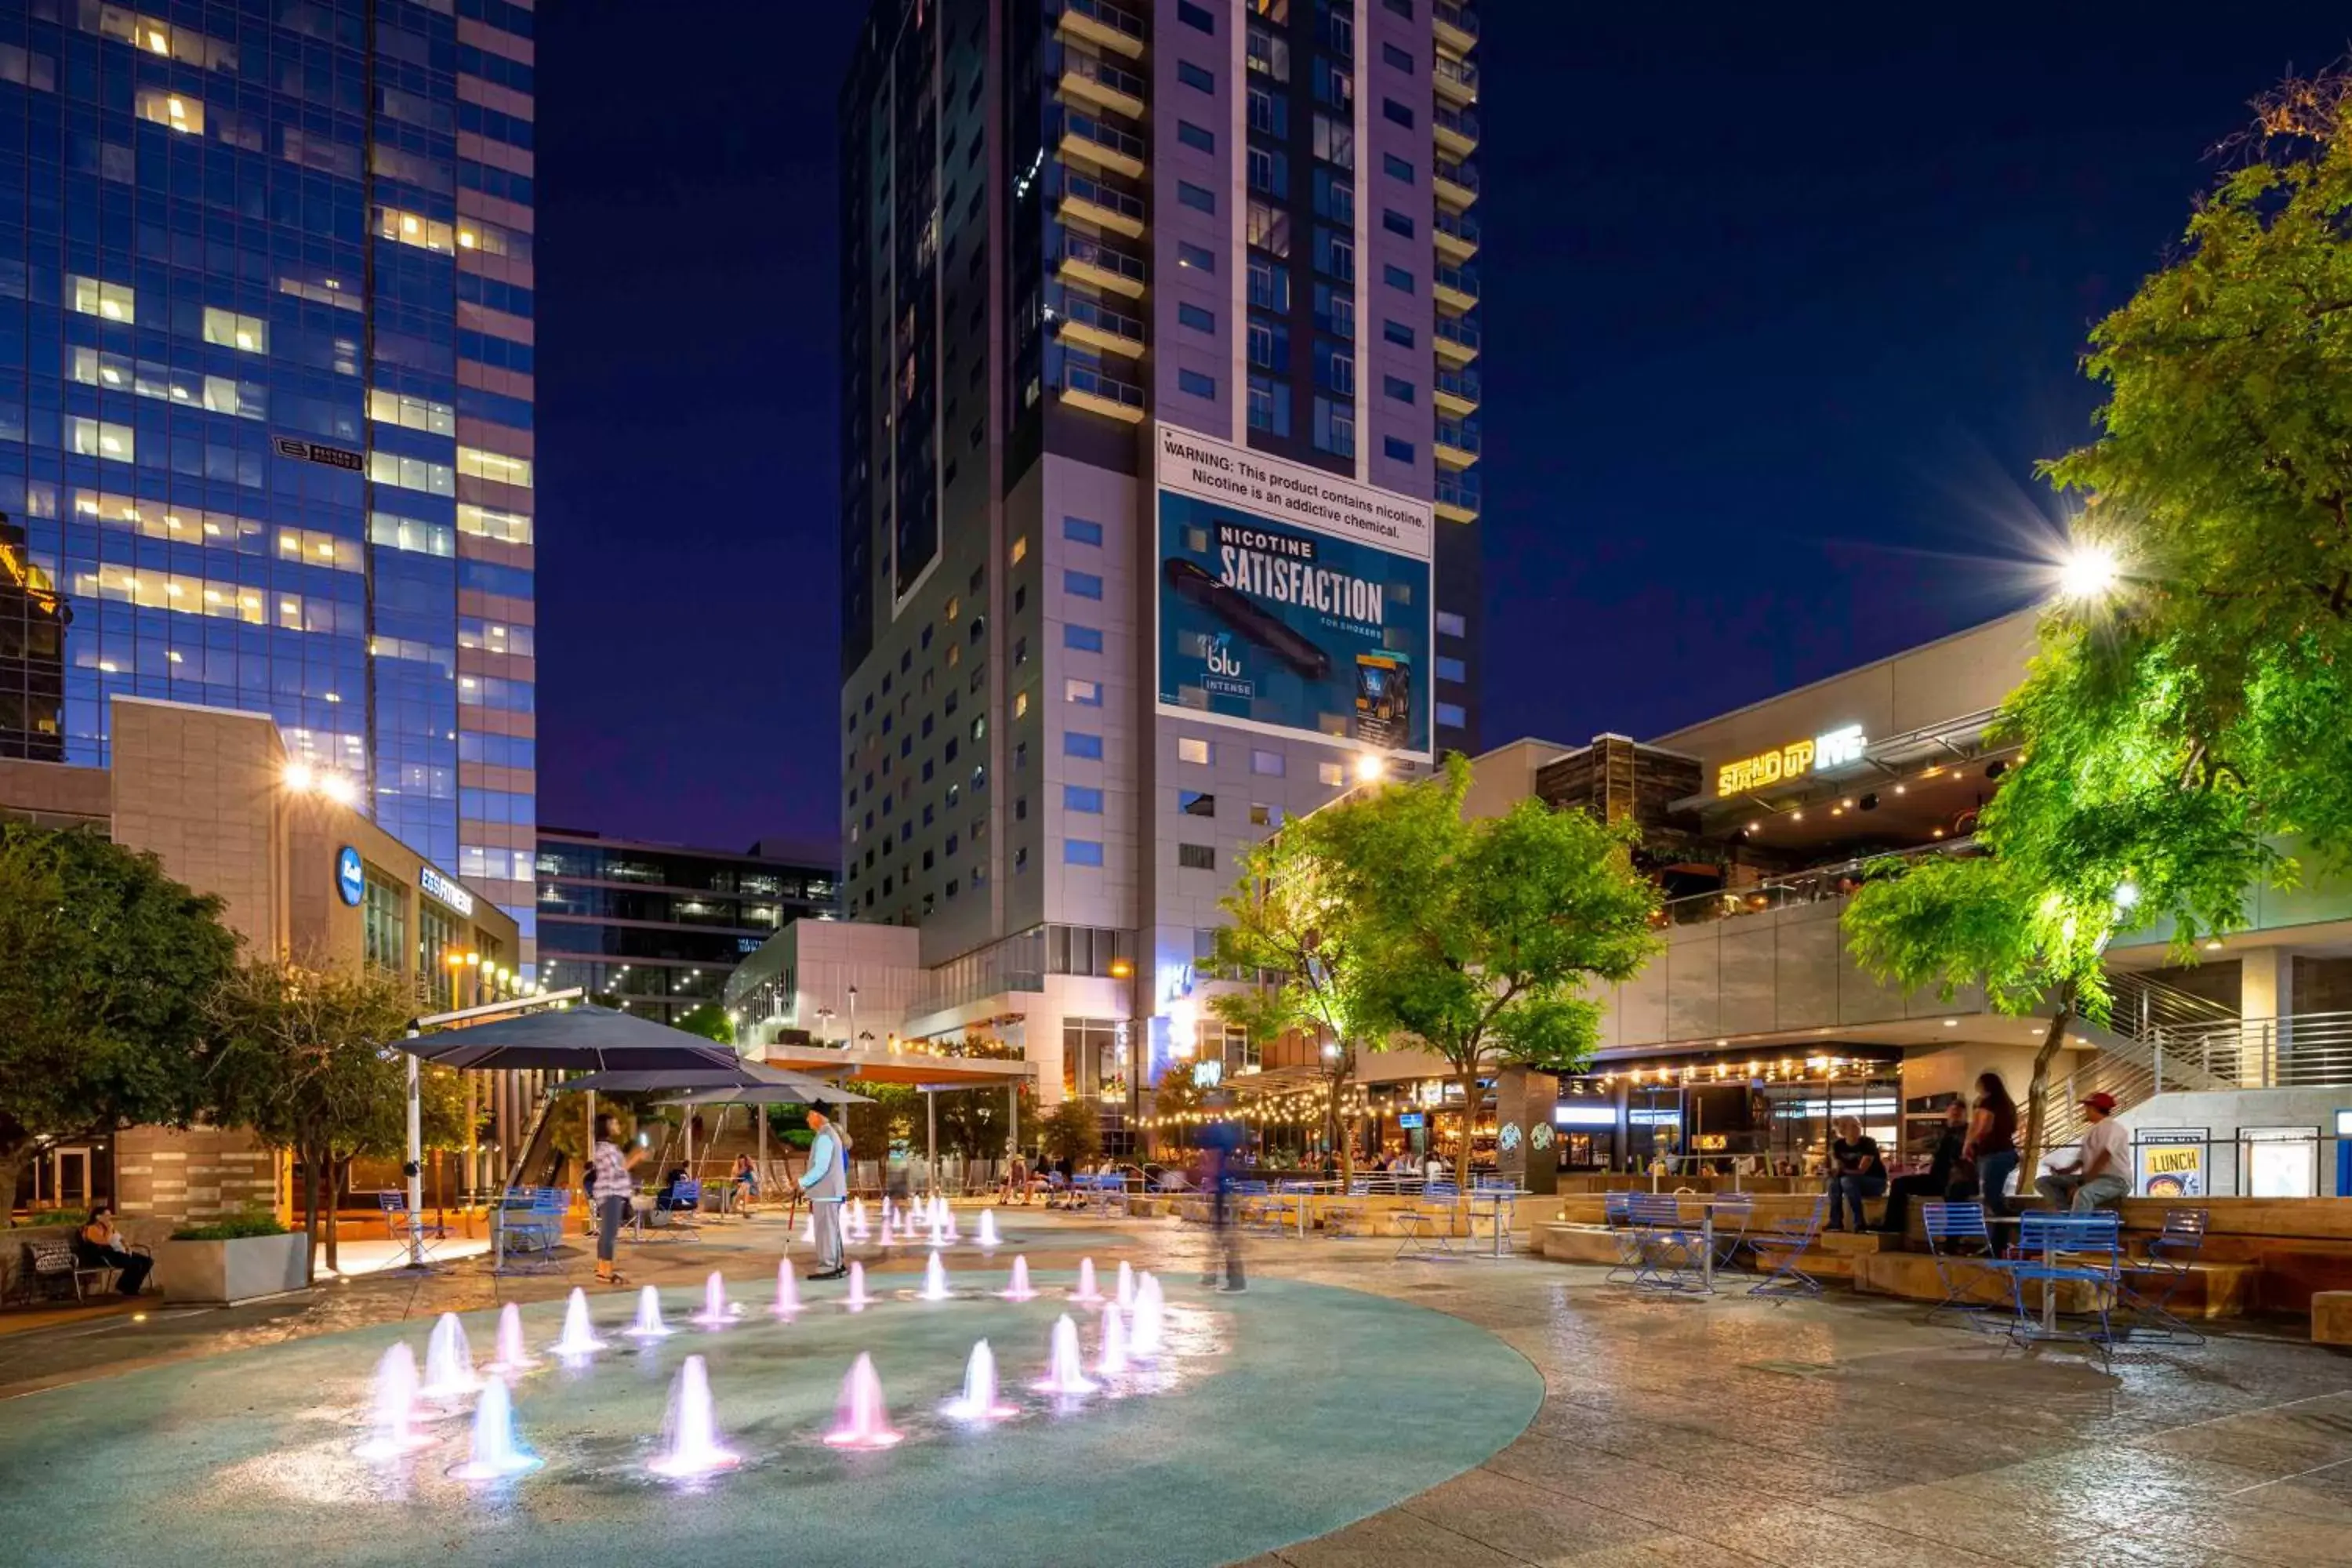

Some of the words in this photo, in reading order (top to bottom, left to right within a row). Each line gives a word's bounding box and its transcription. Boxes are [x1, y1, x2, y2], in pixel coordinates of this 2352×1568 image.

[1164, 441, 1234, 473] WARNING:
[1238, 463, 1266, 482] This
[1269, 474, 1318, 497] product
[1322, 489, 1373, 512] contains
[1376, 504, 1425, 528] nicotine.
[1192, 469, 1247, 495] Nicotine
[1251, 485, 1262, 499] is
[1266, 492, 1282, 506] an
[1285, 498, 1341, 521] addictive
[1344, 514, 1399, 539] chemical.
[1221, 526, 1312, 557] NICOTINE
[1221, 545, 1382, 625] SATISFACTION
[1207, 644, 1240, 677] blu
[1206, 679, 1250, 695] INTENSE
[1718, 750, 1782, 797] STAND
[1784, 739, 1814, 778] UP
[2152, 1151, 2197, 1173] LUNCH
